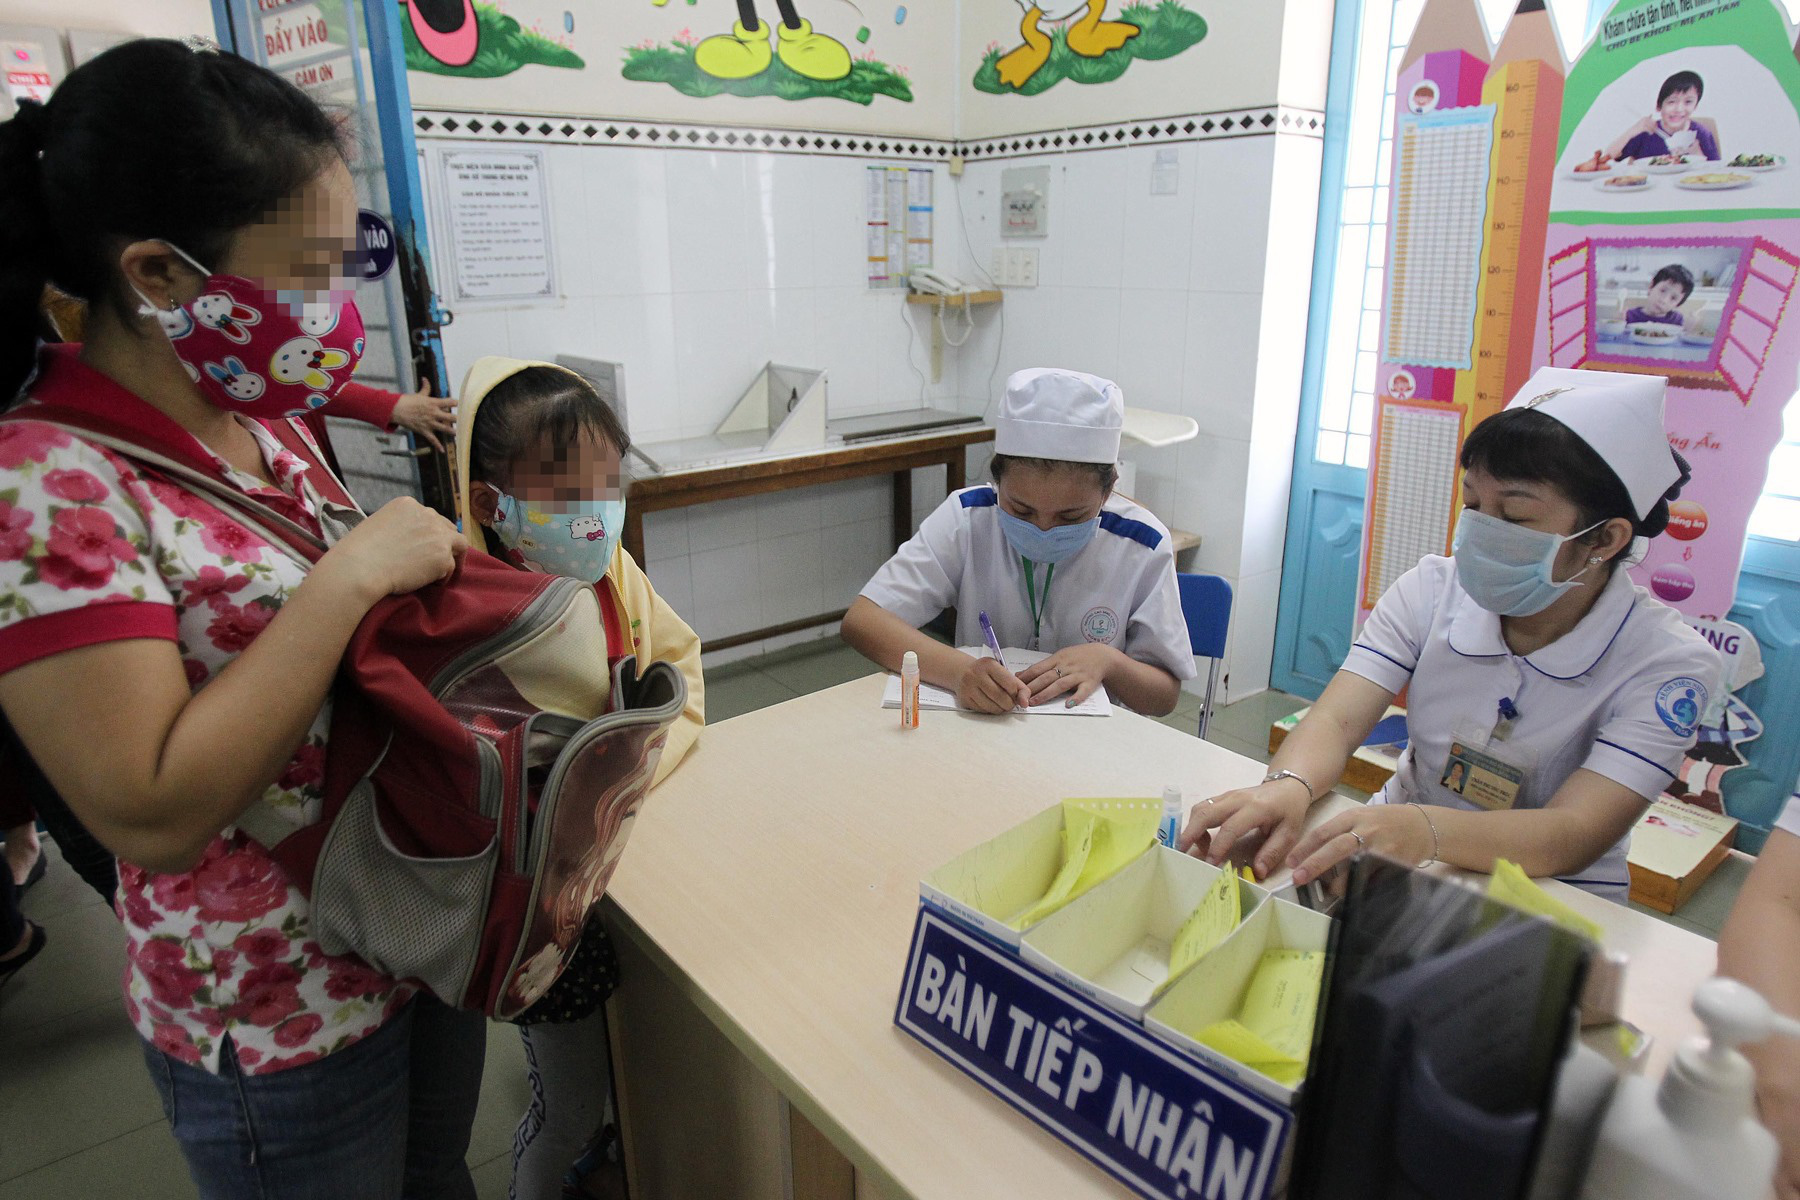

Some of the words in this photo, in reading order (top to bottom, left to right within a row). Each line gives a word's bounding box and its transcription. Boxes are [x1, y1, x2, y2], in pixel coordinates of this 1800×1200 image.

[264, 18, 293, 56] ĐẨY
[296, 15, 328, 48] VÀO
[1506, 83, 1520, 92] 160
[1501, 130, 1515, 139] 150
[1493, 221, 1505, 230] 130
[363, 224, 389, 249] VÀO
[1488, 265, 1500, 274] 120
[1486, 309, 1496, 317] 110
[1479, 350, 1491, 358] 100
[1477, 391, 1487, 399] 90
[915, 952, 998, 1051] BÀN
[1004, 1004, 1104, 1111] TIẾP
[1106, 1072, 1256, 1200] NHẬN
